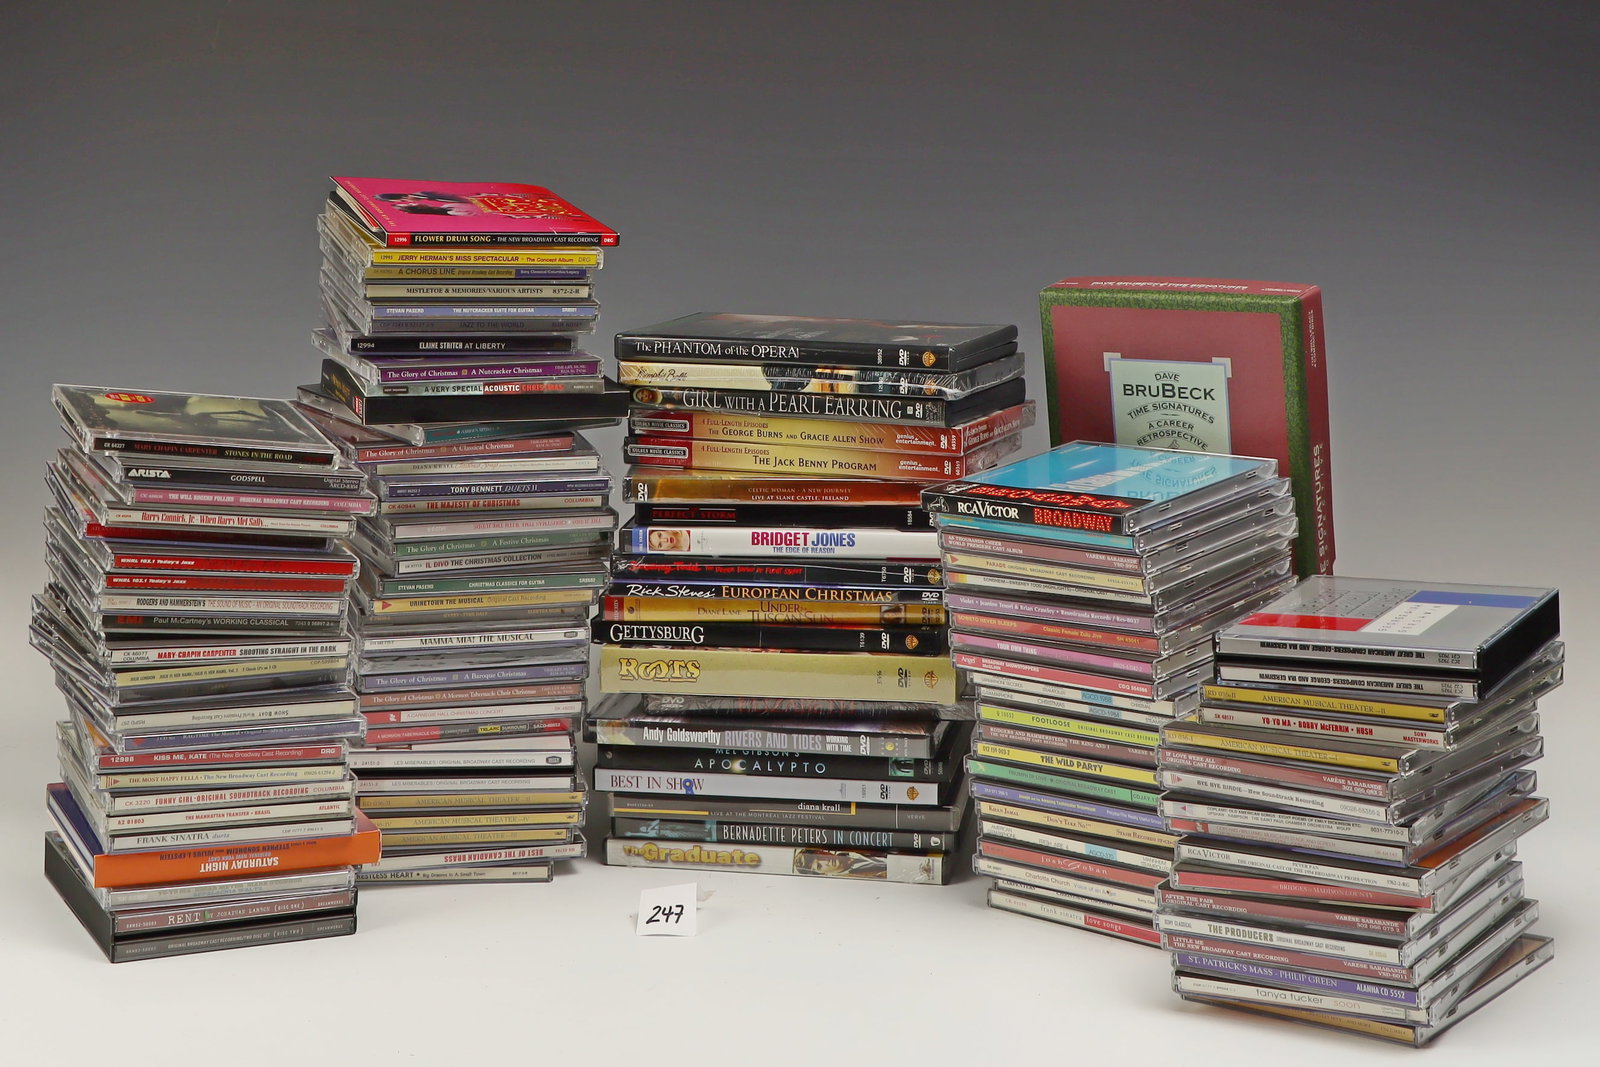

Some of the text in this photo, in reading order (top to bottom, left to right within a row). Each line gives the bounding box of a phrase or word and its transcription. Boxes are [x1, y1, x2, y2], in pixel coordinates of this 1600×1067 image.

[415, 234, 445, 243] FLOWER
[446, 235, 468, 243] DRUM
[470, 235, 491, 243] SONG
[654, 341, 721, 357] PHANTOM
[402, 370, 419, 380] Glory
[428, 368, 459, 377] Christmas
[513, 365, 543, 374] Christmas
[1154, 370, 1181, 383] DAVE
[452, 385, 483, 393] SPECIAL
[484, 384, 520, 393] ACOUSTIC
[1122, 382, 1216, 401] BRUBECK
[682, 388, 722, 409] GIRL
[724, 397, 755, 411] WITH
[759, 399, 766, 411] A
[769, 394, 821, 414] PEARL
[824, 396, 902, 420] EARRING
[1127, 402, 1215, 424] TIME SIGNATURES
[1156, 419, 1196, 432] CAREER
[721, 427, 754, 437] GEORGE
[756, 429, 783, 440] BURNS
[800, 431, 829, 442] GRACIE
[832, 435, 857, 444] ALLEN
[859, 435, 885, 445] SHOW
[1136, 429, 1210, 452] RETROSPECTIVE
[753, 455, 878, 471] THE JACK BENNY PROGRAM
[127, 468, 171, 478] ARISTA
[470, 485, 503, 493] BENNETT
[440, 500, 471, 508] MAJESTY
[482, 499, 520, 507] CHRISTMAS
[751, 531, 857, 548] BRIDGET JONES
[464, 556, 502, 566] CHRISTMAS
[503, 553, 542, 562] COLLECTION
[626, 584, 663, 597] Rick
[721, 585, 800, 600] EUROPEAN
[804, 588, 893, 602] CHRISTMAS
[153, 617, 169, 625] Paul
[213, 618, 249, 626] WORKING
[250, 618, 289, 627] CLASSICAL
[497, 633, 534, 641] MUSICAL
[609, 623, 705, 645] GETTYSBURG
[270, 647, 299, 656] STRAIGHT
[307, 645, 319, 654] THE
[320, 645, 337, 653] DARK
[618, 657, 701, 683] ROOTS
[1262, 694, 1302, 705] AMERICAN
[1303, 698, 1338, 709] MUSICAL
[1031, 716, 1071, 729] FOOTLOOSE
[1298, 719, 1319, 730] BOBBY
[1319, 722, 1350, 733] McFERRIN
[1356, 725, 1374, 736] HUSH
[643, 726, 823, 750] Andy Goldsworthy RIVERS AND TIDES
[825, 735, 849, 744] WORKING
[825, 743, 852, 753] WITH TIME
[694, 758, 827, 774] APOCALYPTO
[1040, 755, 1104, 774] THE WILD PARTY
[610, 775, 706, 793] BEST IN SHOW
[797, 803, 841, 812] diana krall
[136, 835, 168, 844] FRANK
[170, 833, 209, 843] SINATRA
[723, 825, 894, 847] BERNADETTE PETERS IN CONCERT
[643, 842, 762, 867] Graduate
[199, 856, 279, 873] SATURDAY NIGHT
[167, 912, 201, 925] RENT
[645, 904, 685, 925] 247
[1207, 923, 1275, 943] THE PRODUCERS
[1187, 955, 1338, 988] ST. PATRICK'S MASS PHILIP GREEN
[1255, 987, 1288, 1002] tanya
[1288, 992, 1325, 1006] tucker
